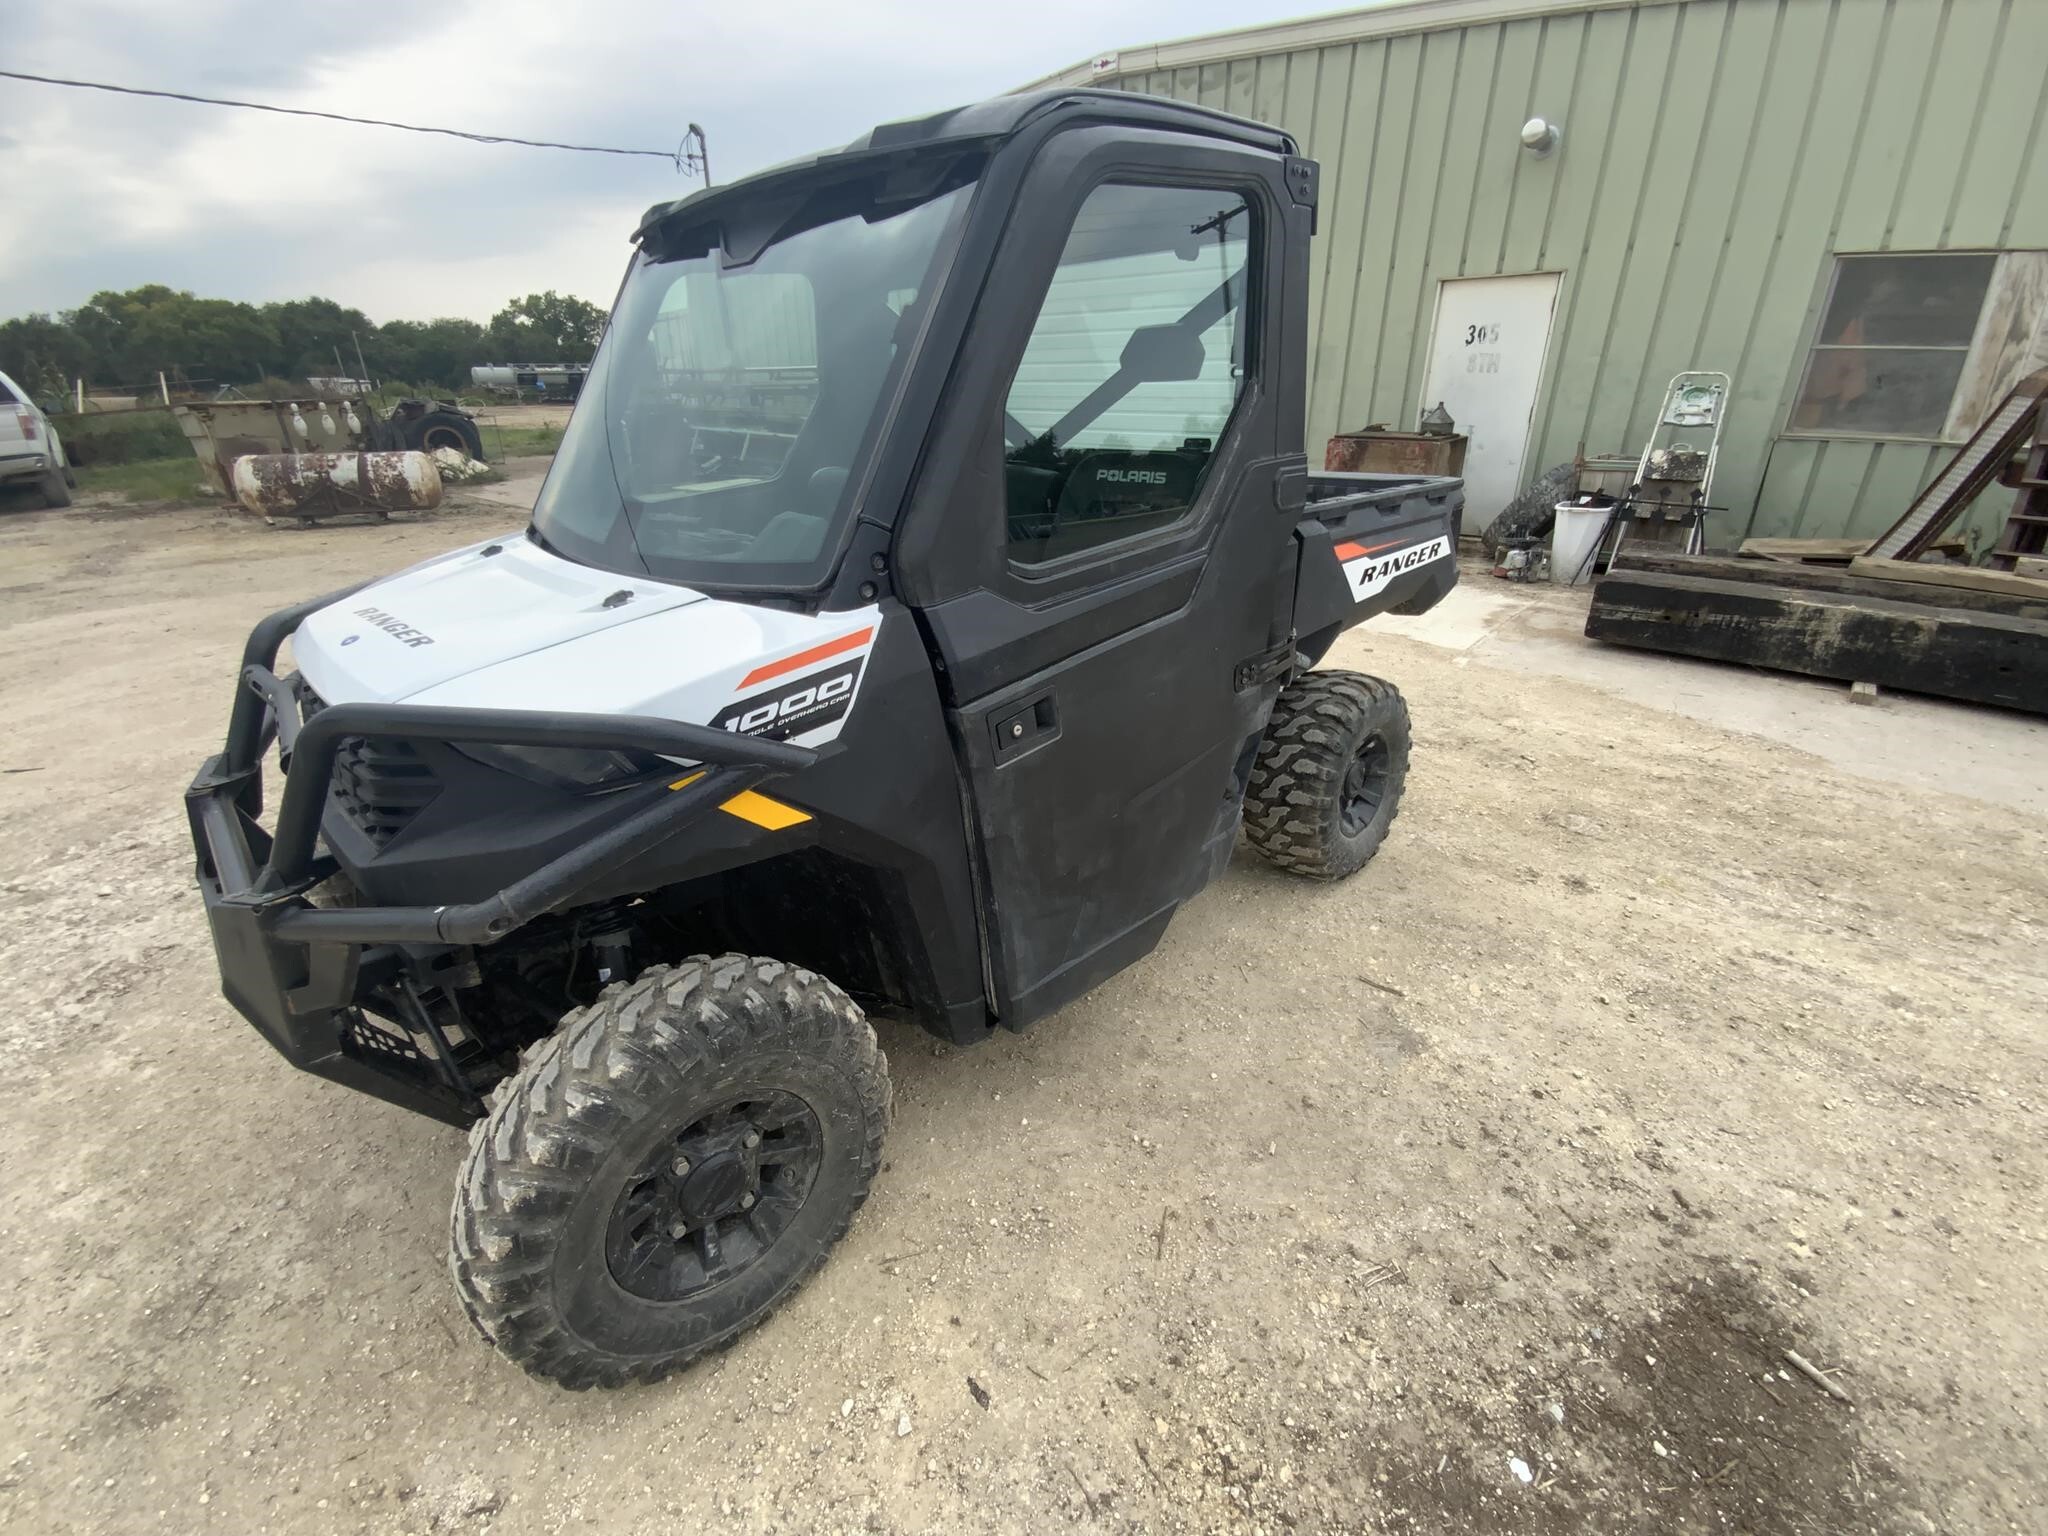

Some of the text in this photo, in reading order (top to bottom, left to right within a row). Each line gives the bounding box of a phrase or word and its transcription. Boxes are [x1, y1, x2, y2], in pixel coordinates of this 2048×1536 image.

[1465, 323, 1501, 346] 305
[1096, 469, 1167, 484] POLARIS
[1359, 542, 1441, 586] RANGER
[353, 607, 435, 648] RANGER
[724, 673, 853, 732] 1000
[777, 702, 829, 727] OVERHEAD
